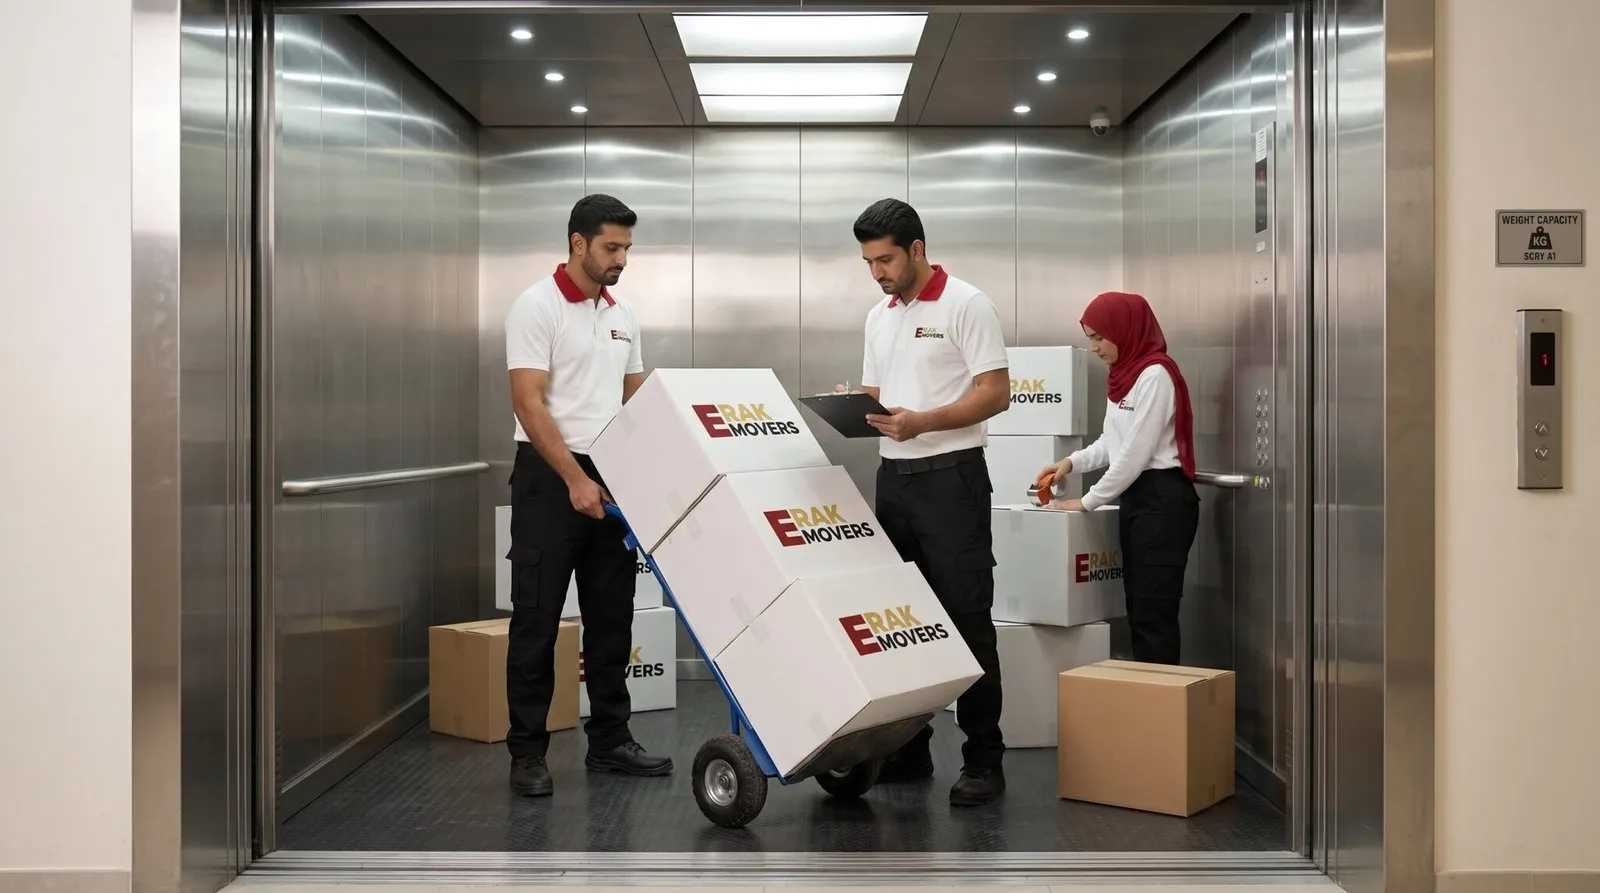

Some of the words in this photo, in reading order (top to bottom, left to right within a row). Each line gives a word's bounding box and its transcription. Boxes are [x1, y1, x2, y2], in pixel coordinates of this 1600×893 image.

[1502, 215, 1535, 225] WEIGHT
[1537, 215, 1578, 225] CAPACITY
[1533, 236, 1548, 246] KG
[1524, 252, 1545, 261] SCRY
[728, 421, 800, 437] MOVERS
[801, 522, 875, 544] MOVERS
[876, 623, 949, 651] MOVERS
